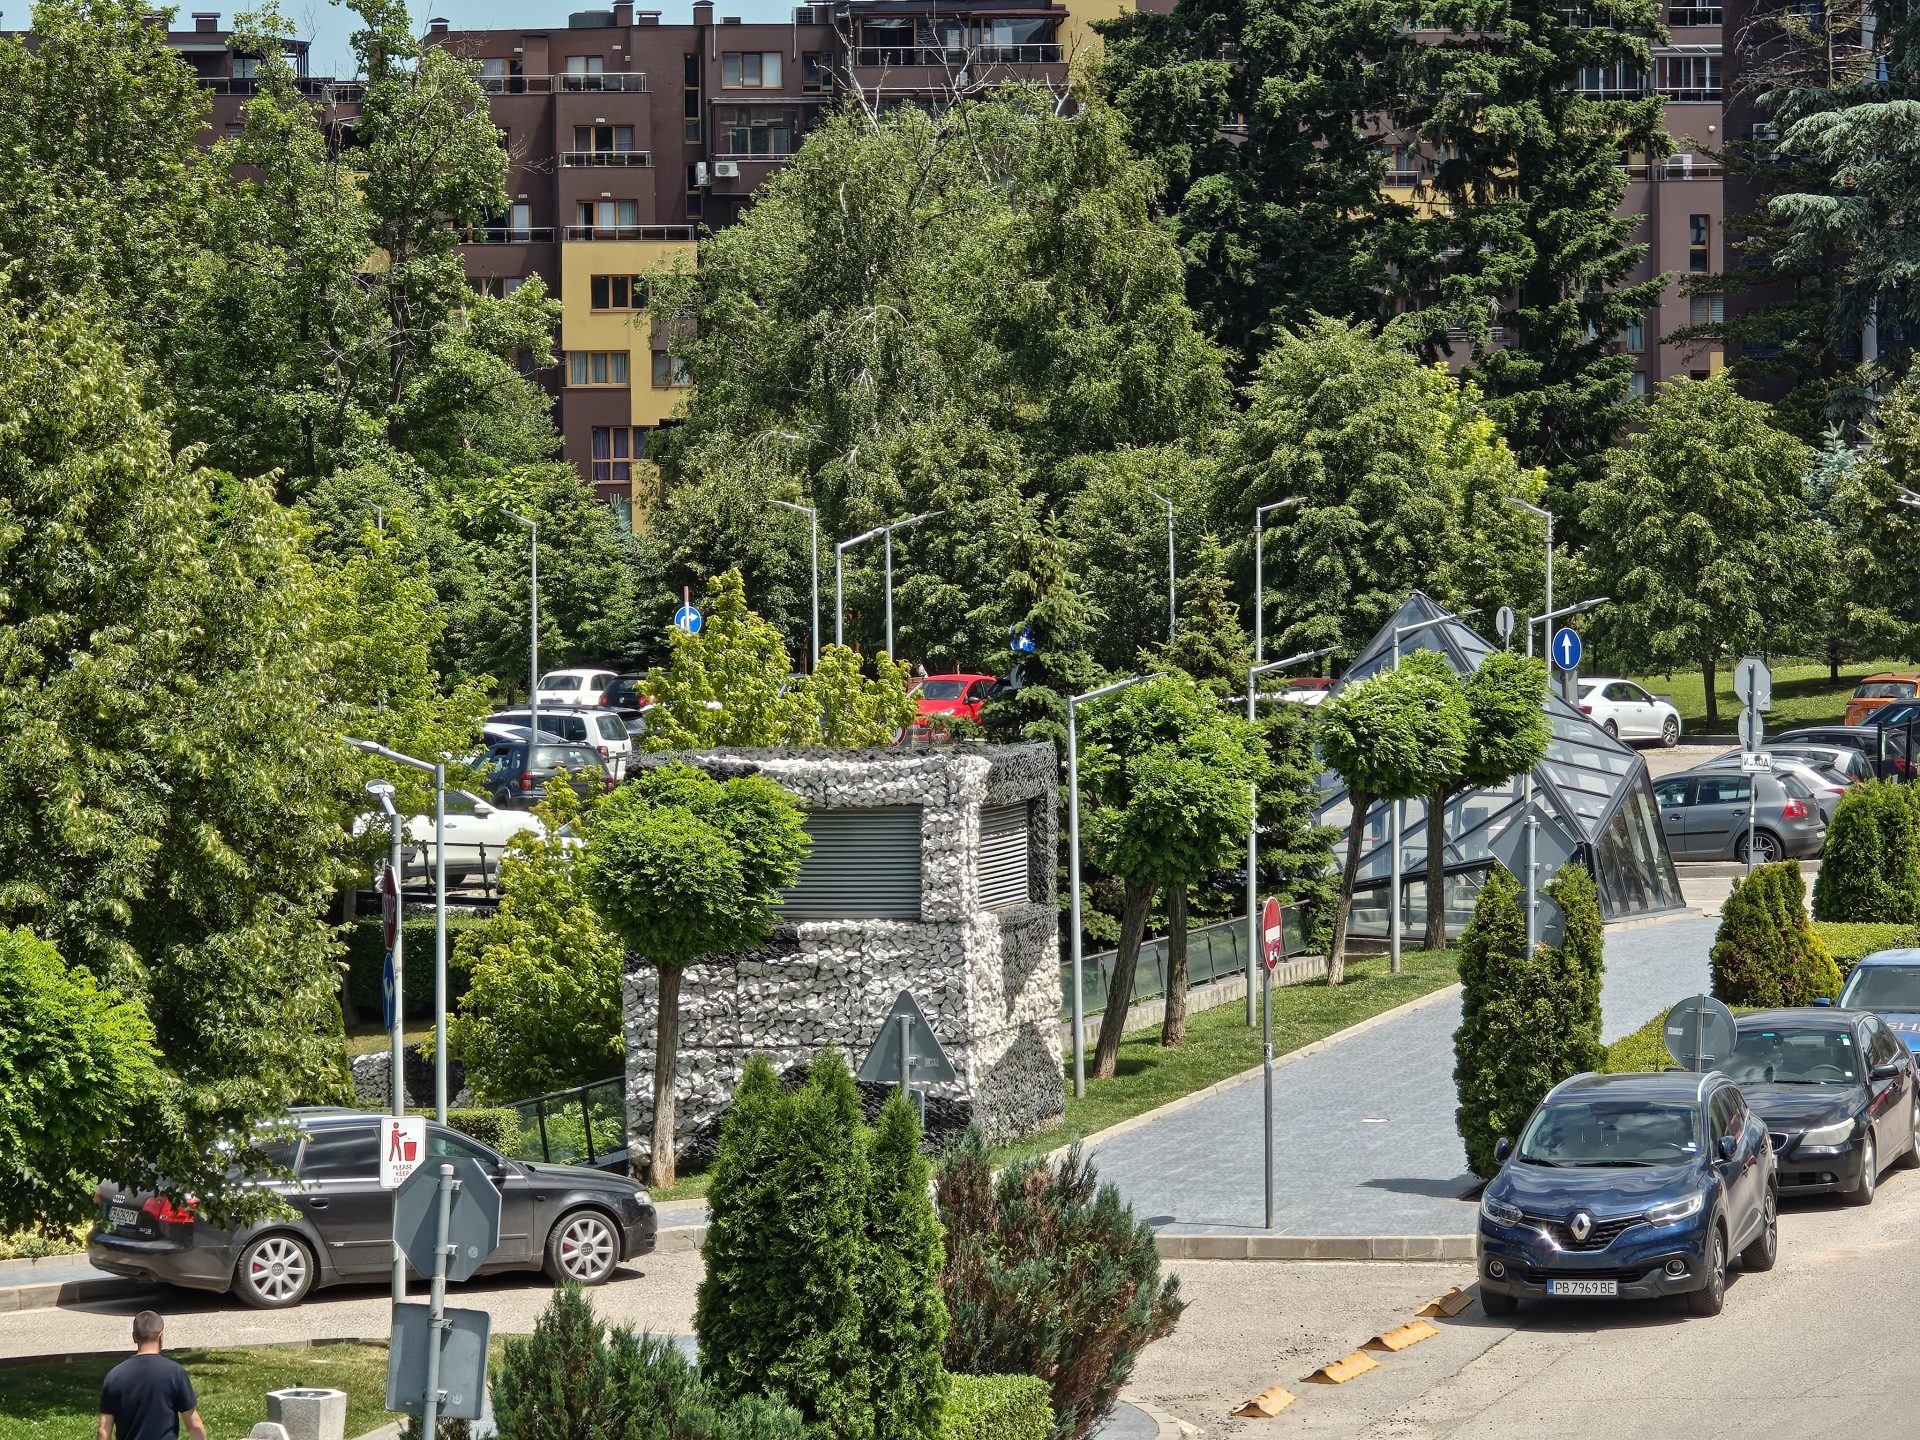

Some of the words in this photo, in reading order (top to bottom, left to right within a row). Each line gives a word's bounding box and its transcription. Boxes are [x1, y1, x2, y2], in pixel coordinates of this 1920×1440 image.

[1887, 1022, 1920, 1032] SH
[1555, 1282, 1570, 1293] PB
[1571, 1282, 1598, 1293] 7969
[1600, 1282, 1615, 1293] BE
